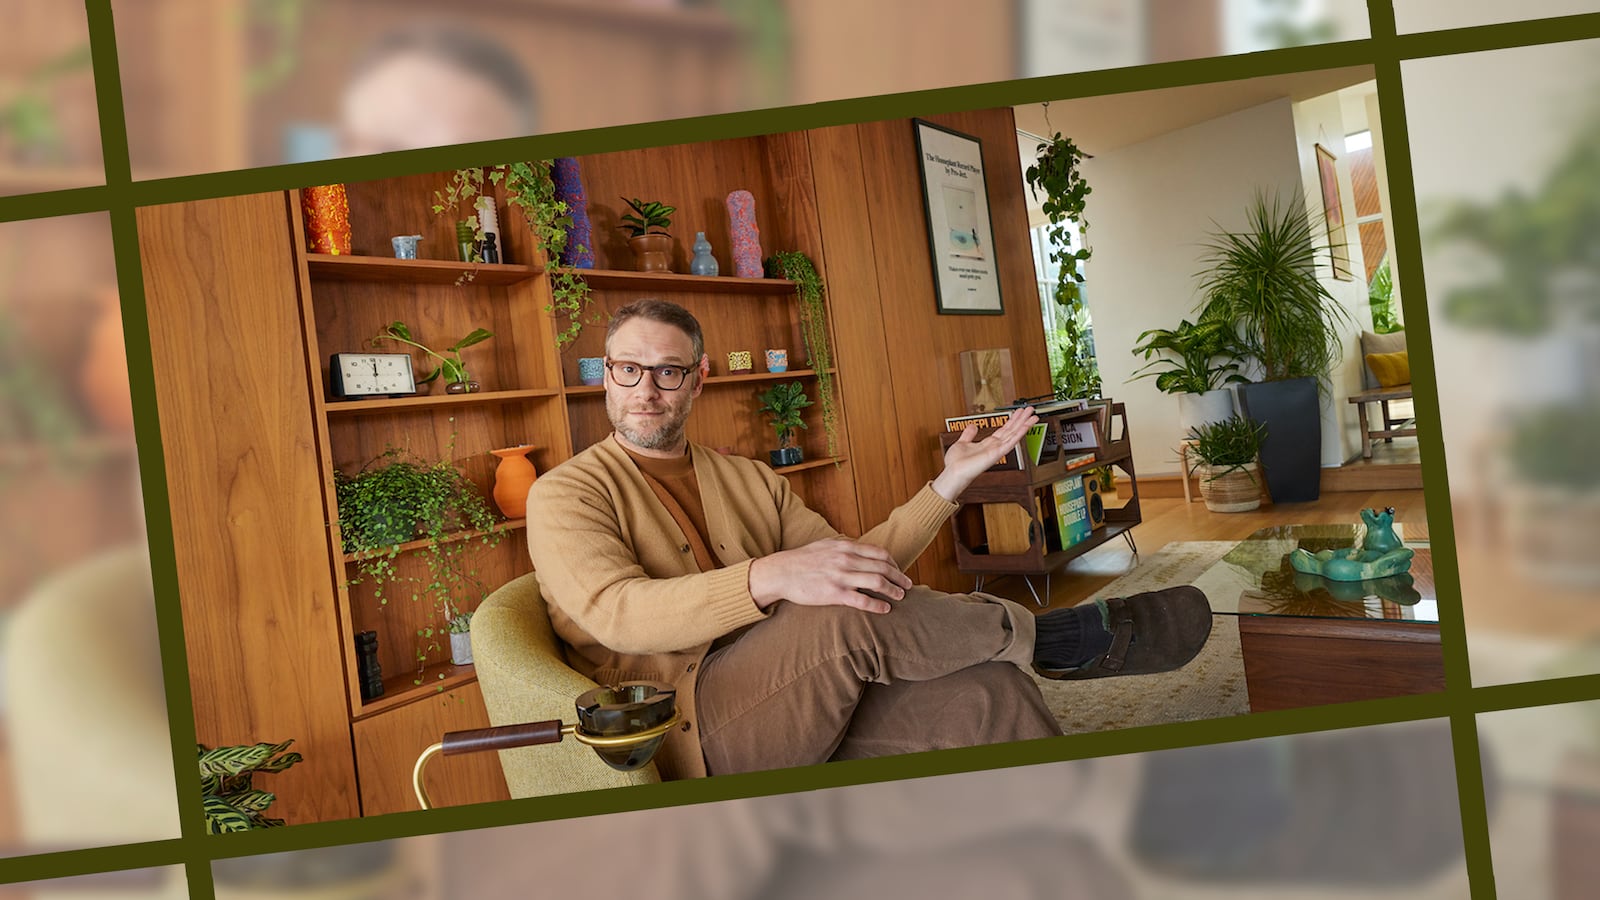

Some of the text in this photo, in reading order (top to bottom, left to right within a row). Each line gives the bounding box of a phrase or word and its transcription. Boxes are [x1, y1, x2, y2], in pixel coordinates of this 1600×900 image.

[925, 153, 935, 161] The
[1047, 433, 1083, 446] SESION
[1056, 475, 1083, 496] HOUSEPLANT
[1063, 509, 1081, 527] DOUBLE
